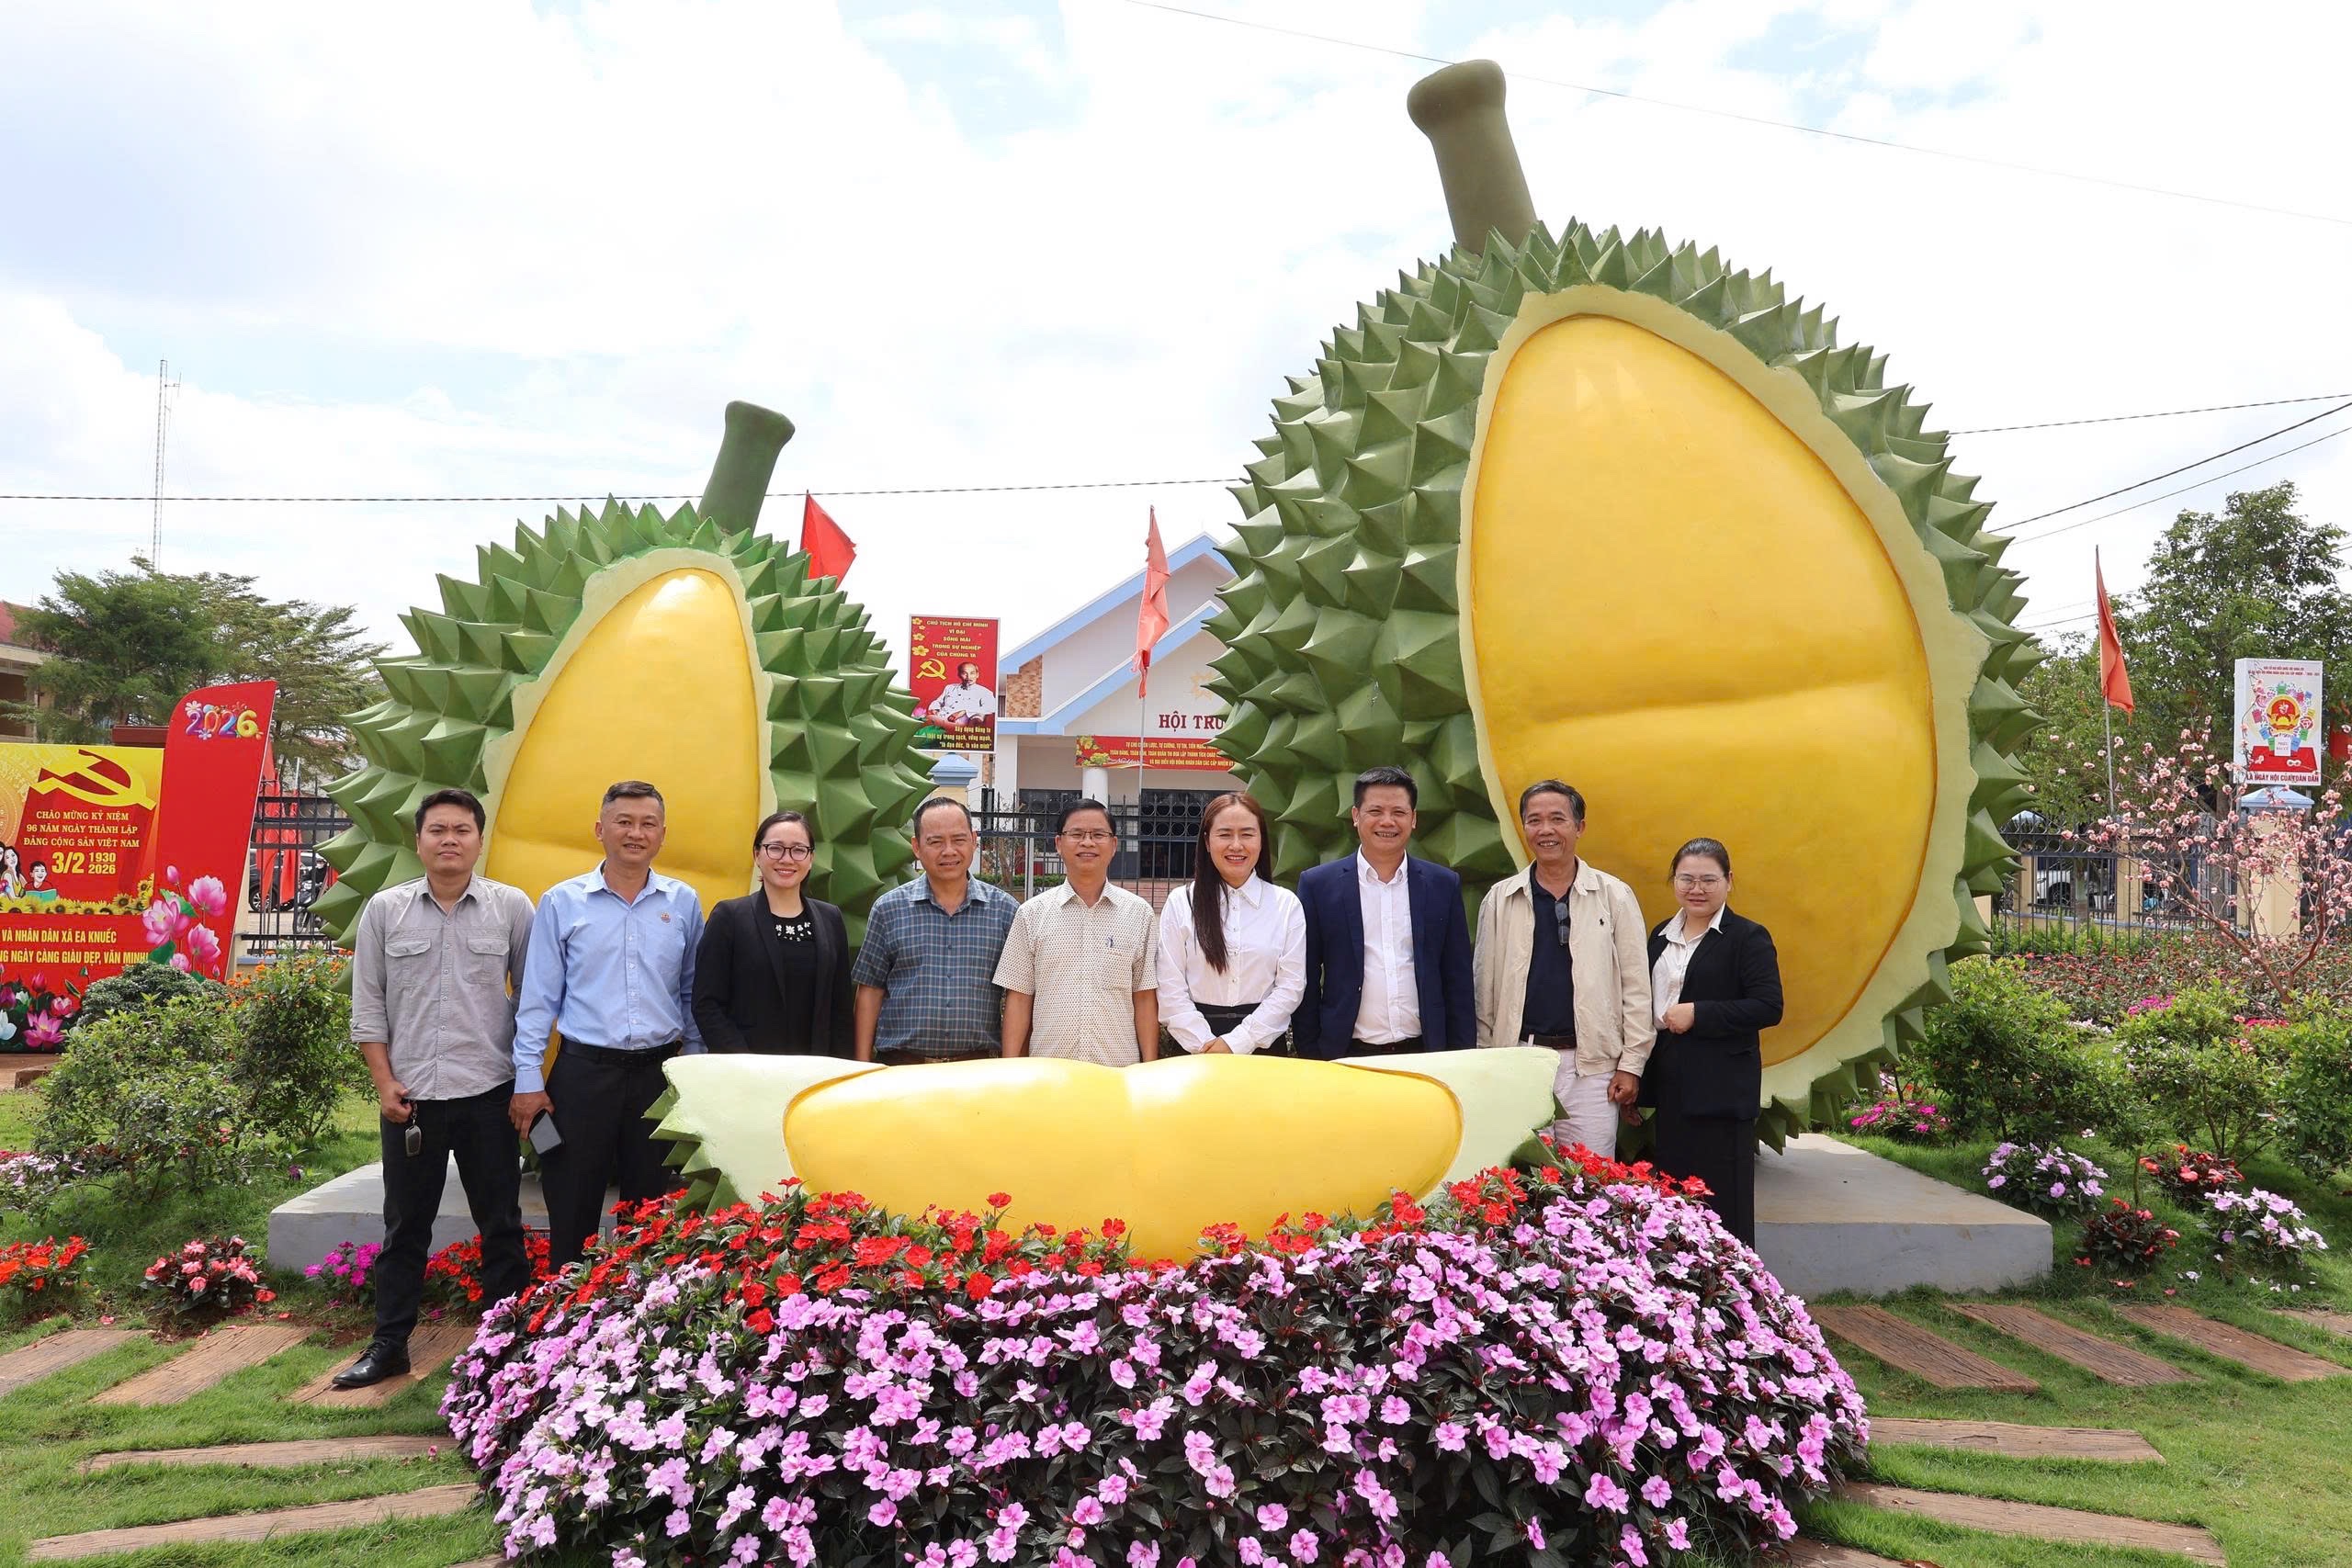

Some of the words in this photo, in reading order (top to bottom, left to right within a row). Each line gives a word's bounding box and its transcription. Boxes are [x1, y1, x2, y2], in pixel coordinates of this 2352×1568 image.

[186, 710, 258, 738] 2026
[1159, 710, 1187, 732] HỘI
[37, 809, 61, 819] CHÀO
[62, 810, 88, 820] MỪNG
[91, 810, 104, 820] KỶ
[107, 811, 129, 821] NIỆM
[27, 824, 37, 832] 96
[40, 823, 59, 832] NĂM
[62, 823, 86, 833] NGÀY
[88, 824, 119, 834] THÀNH
[121, 825, 138, 836] LẬP
[24, 835, 49, 845] ĐẢNG
[51, 836, 74, 848] CỘNG
[77, 836, 95, 847] SẢN
[97, 838, 118, 848] VIỆT
[120, 840, 140, 848] NAM
[51, 852, 85, 874] 3/2
[88, 852, 116, 863] 1930
[88, 863, 116, 874] 2026
[2, 927, 13, 942] VÀ
[15, 928, 40, 942] NHÂN
[41, 928, 59, 942] DÂN
[62, 928, 74, 942] XÃ
[74, 931, 86, 943] EA
[88, 927, 118, 943] KNUẾC
[11, 948, 34, 963] NGÀY
[37, 948, 59, 964] CÀNG
[62, 949, 82, 964] GIÀU
[84, 951, 101, 965] ĐẸP,
[104, 949, 120, 964] VĂN
